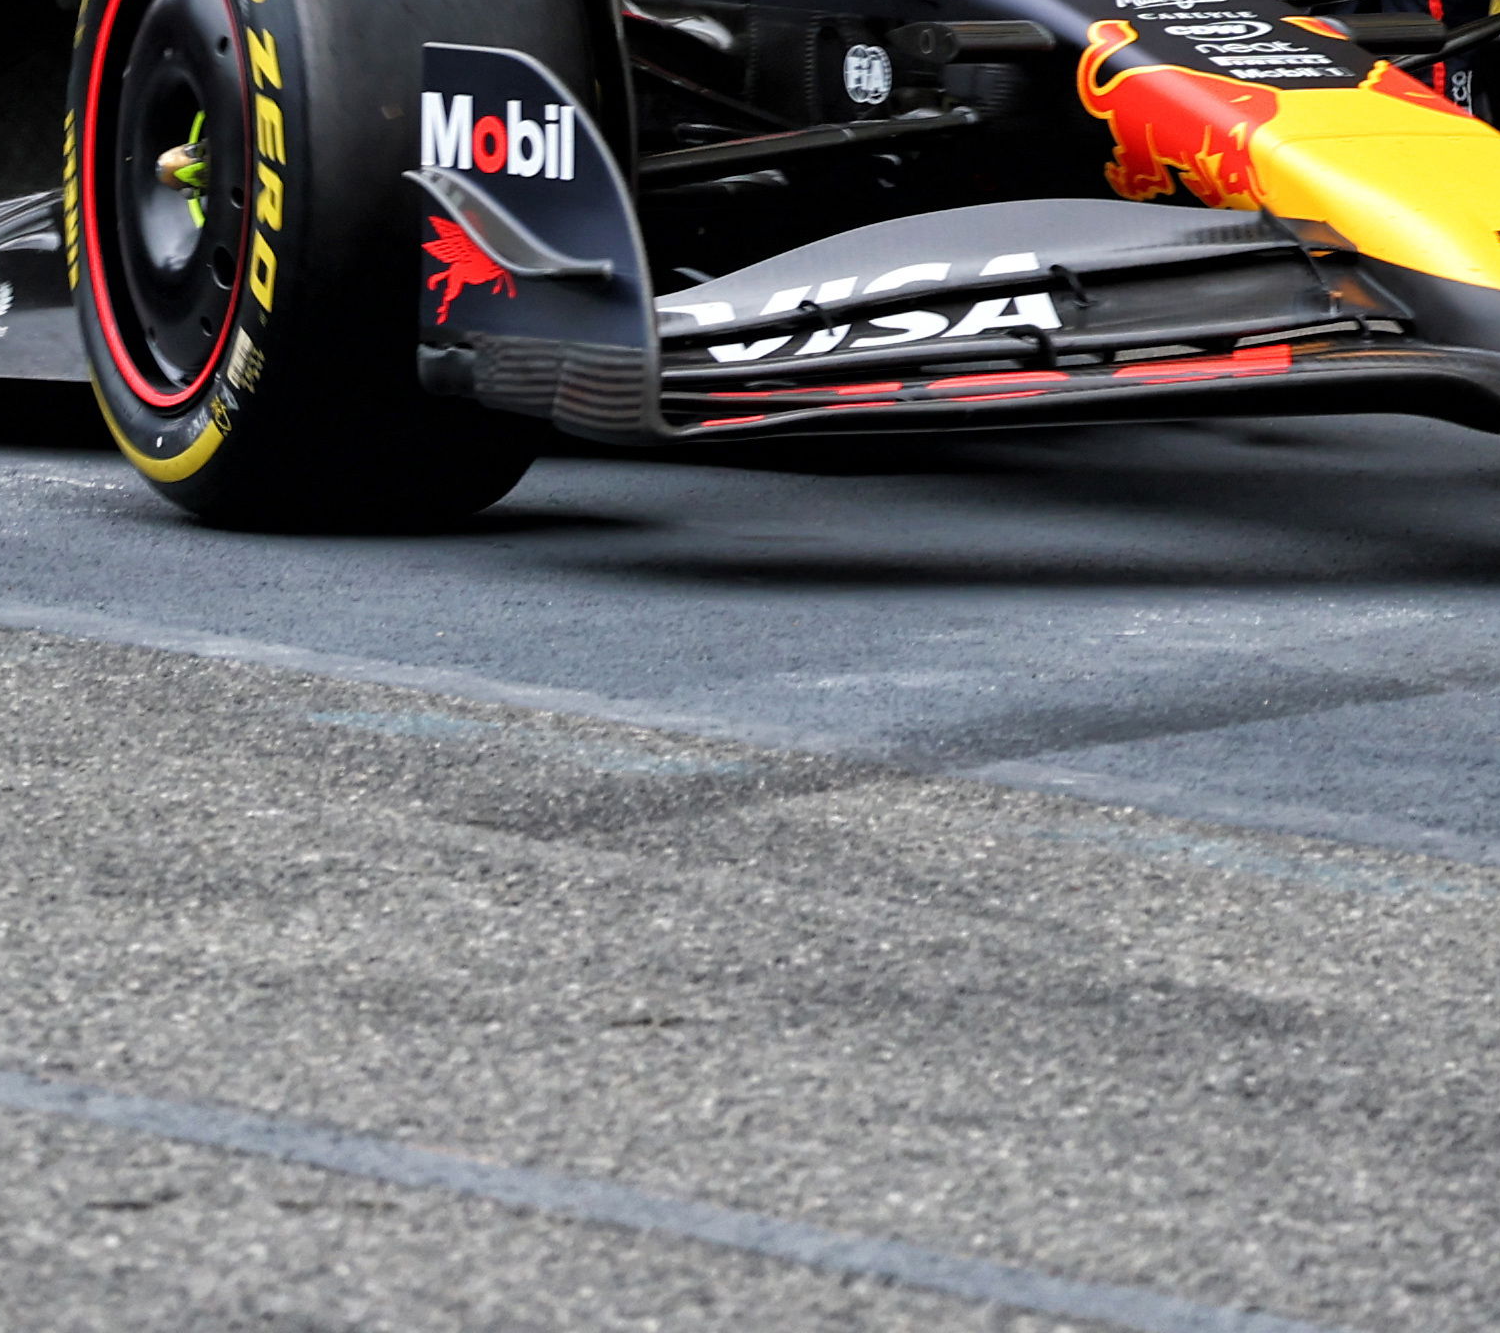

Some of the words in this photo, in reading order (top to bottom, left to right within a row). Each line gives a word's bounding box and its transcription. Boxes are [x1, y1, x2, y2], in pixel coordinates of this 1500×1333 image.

[1136, 11, 1258, 20] CARLYLE
[1208, 54, 1332, 66] PIRELLI
[1230, 68, 1318, 79] Mobil
[420, 90, 576, 182] Mobil
[246, 26, 287, 313] ZERO
[657, 252, 1063, 364] VISA
